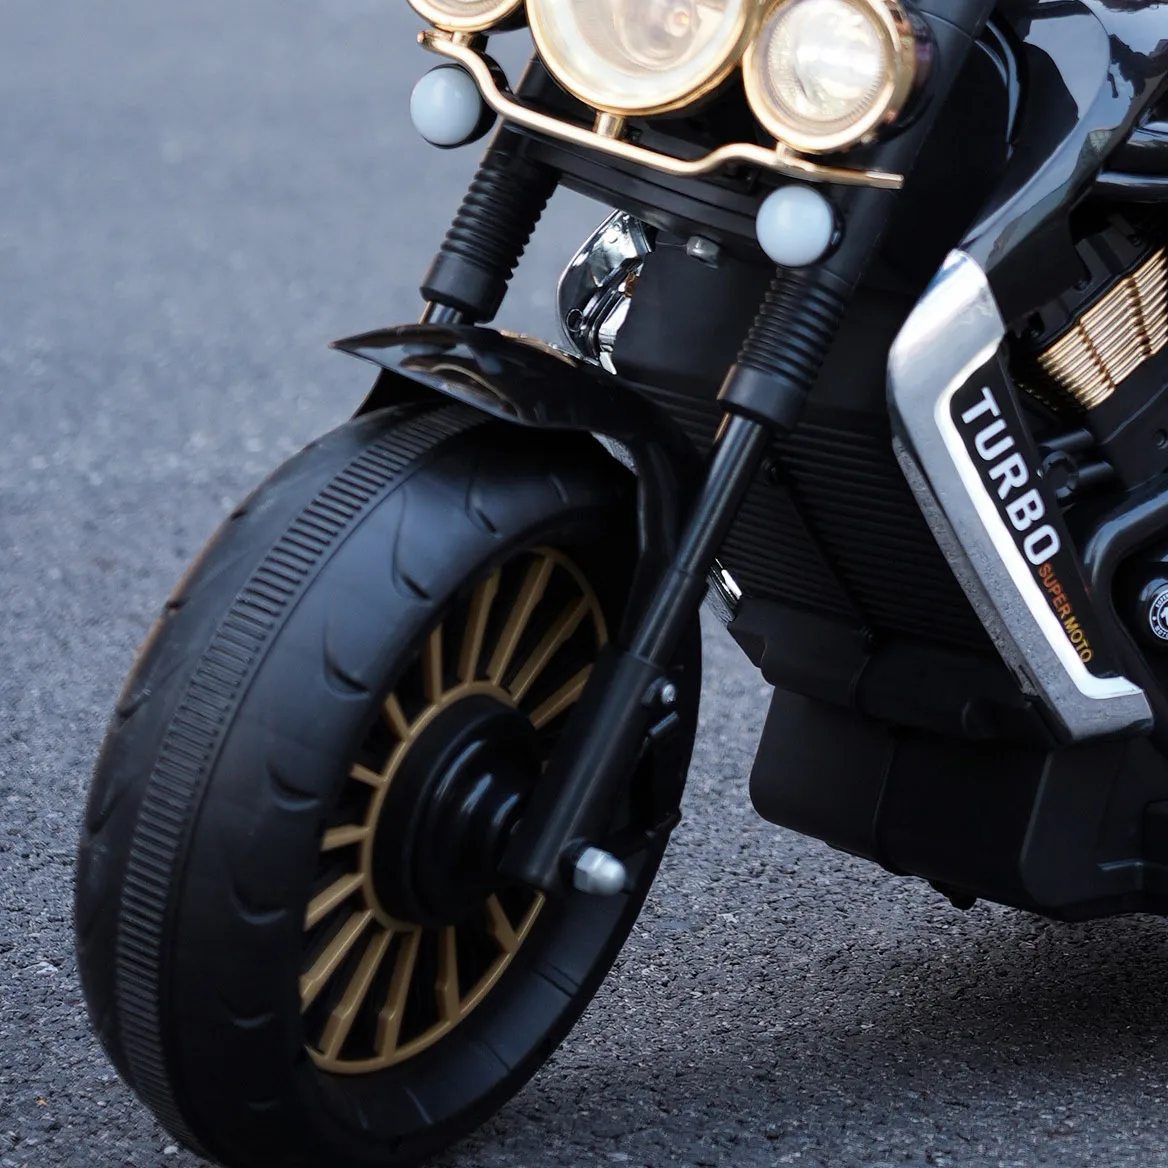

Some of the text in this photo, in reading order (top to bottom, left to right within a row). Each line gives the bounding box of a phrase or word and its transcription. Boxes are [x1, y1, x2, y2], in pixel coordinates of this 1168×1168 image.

[961, 386, 1061, 566] TURBO
[1038, 563, 1093, 663] SUPER MOTO
